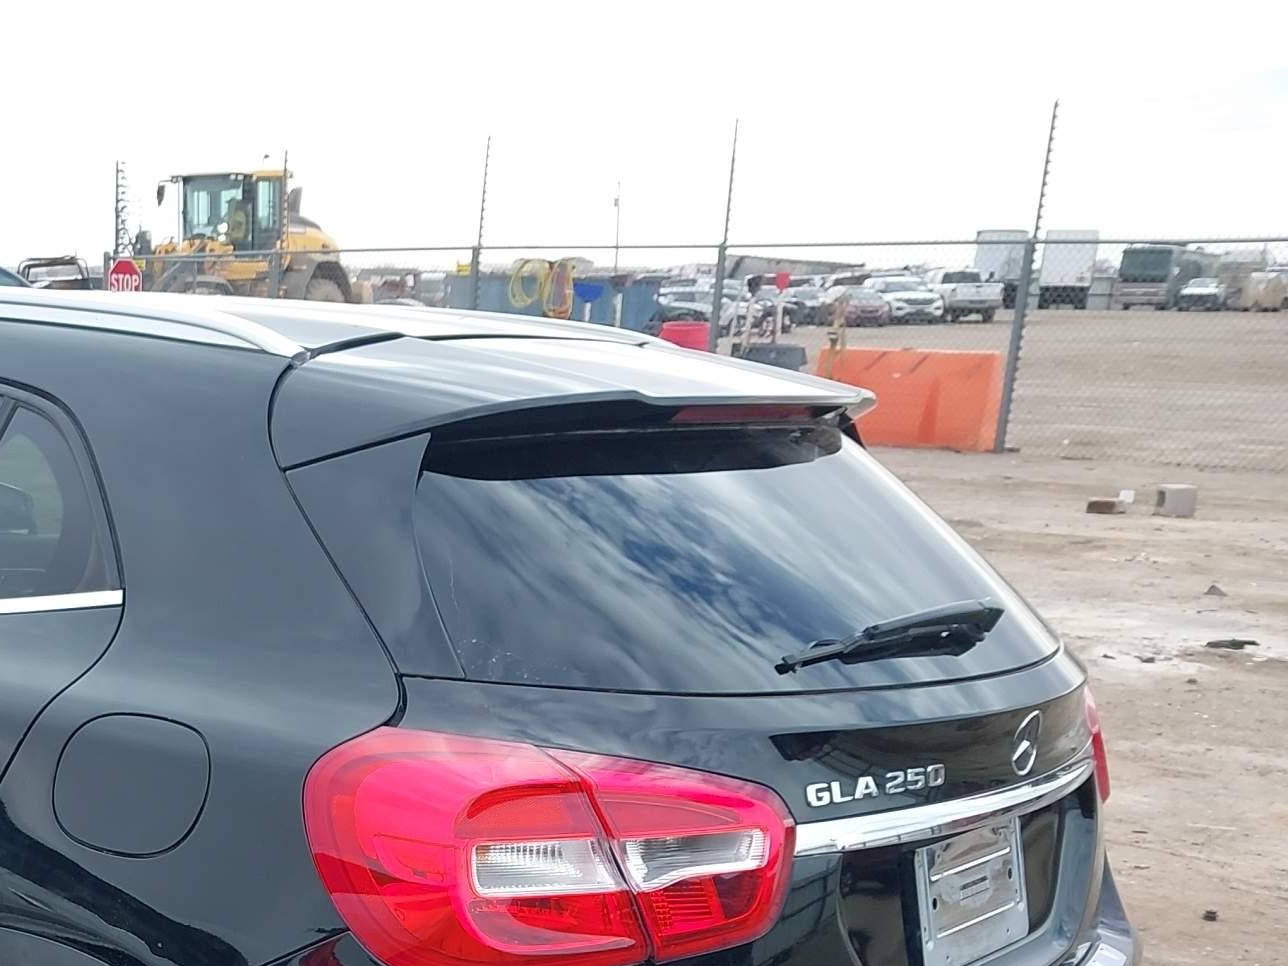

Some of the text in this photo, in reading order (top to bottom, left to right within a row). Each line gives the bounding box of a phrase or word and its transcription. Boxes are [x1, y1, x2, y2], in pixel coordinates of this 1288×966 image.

[111, 273, 140, 292] STOP
[806, 763, 946, 808] GLA 250
